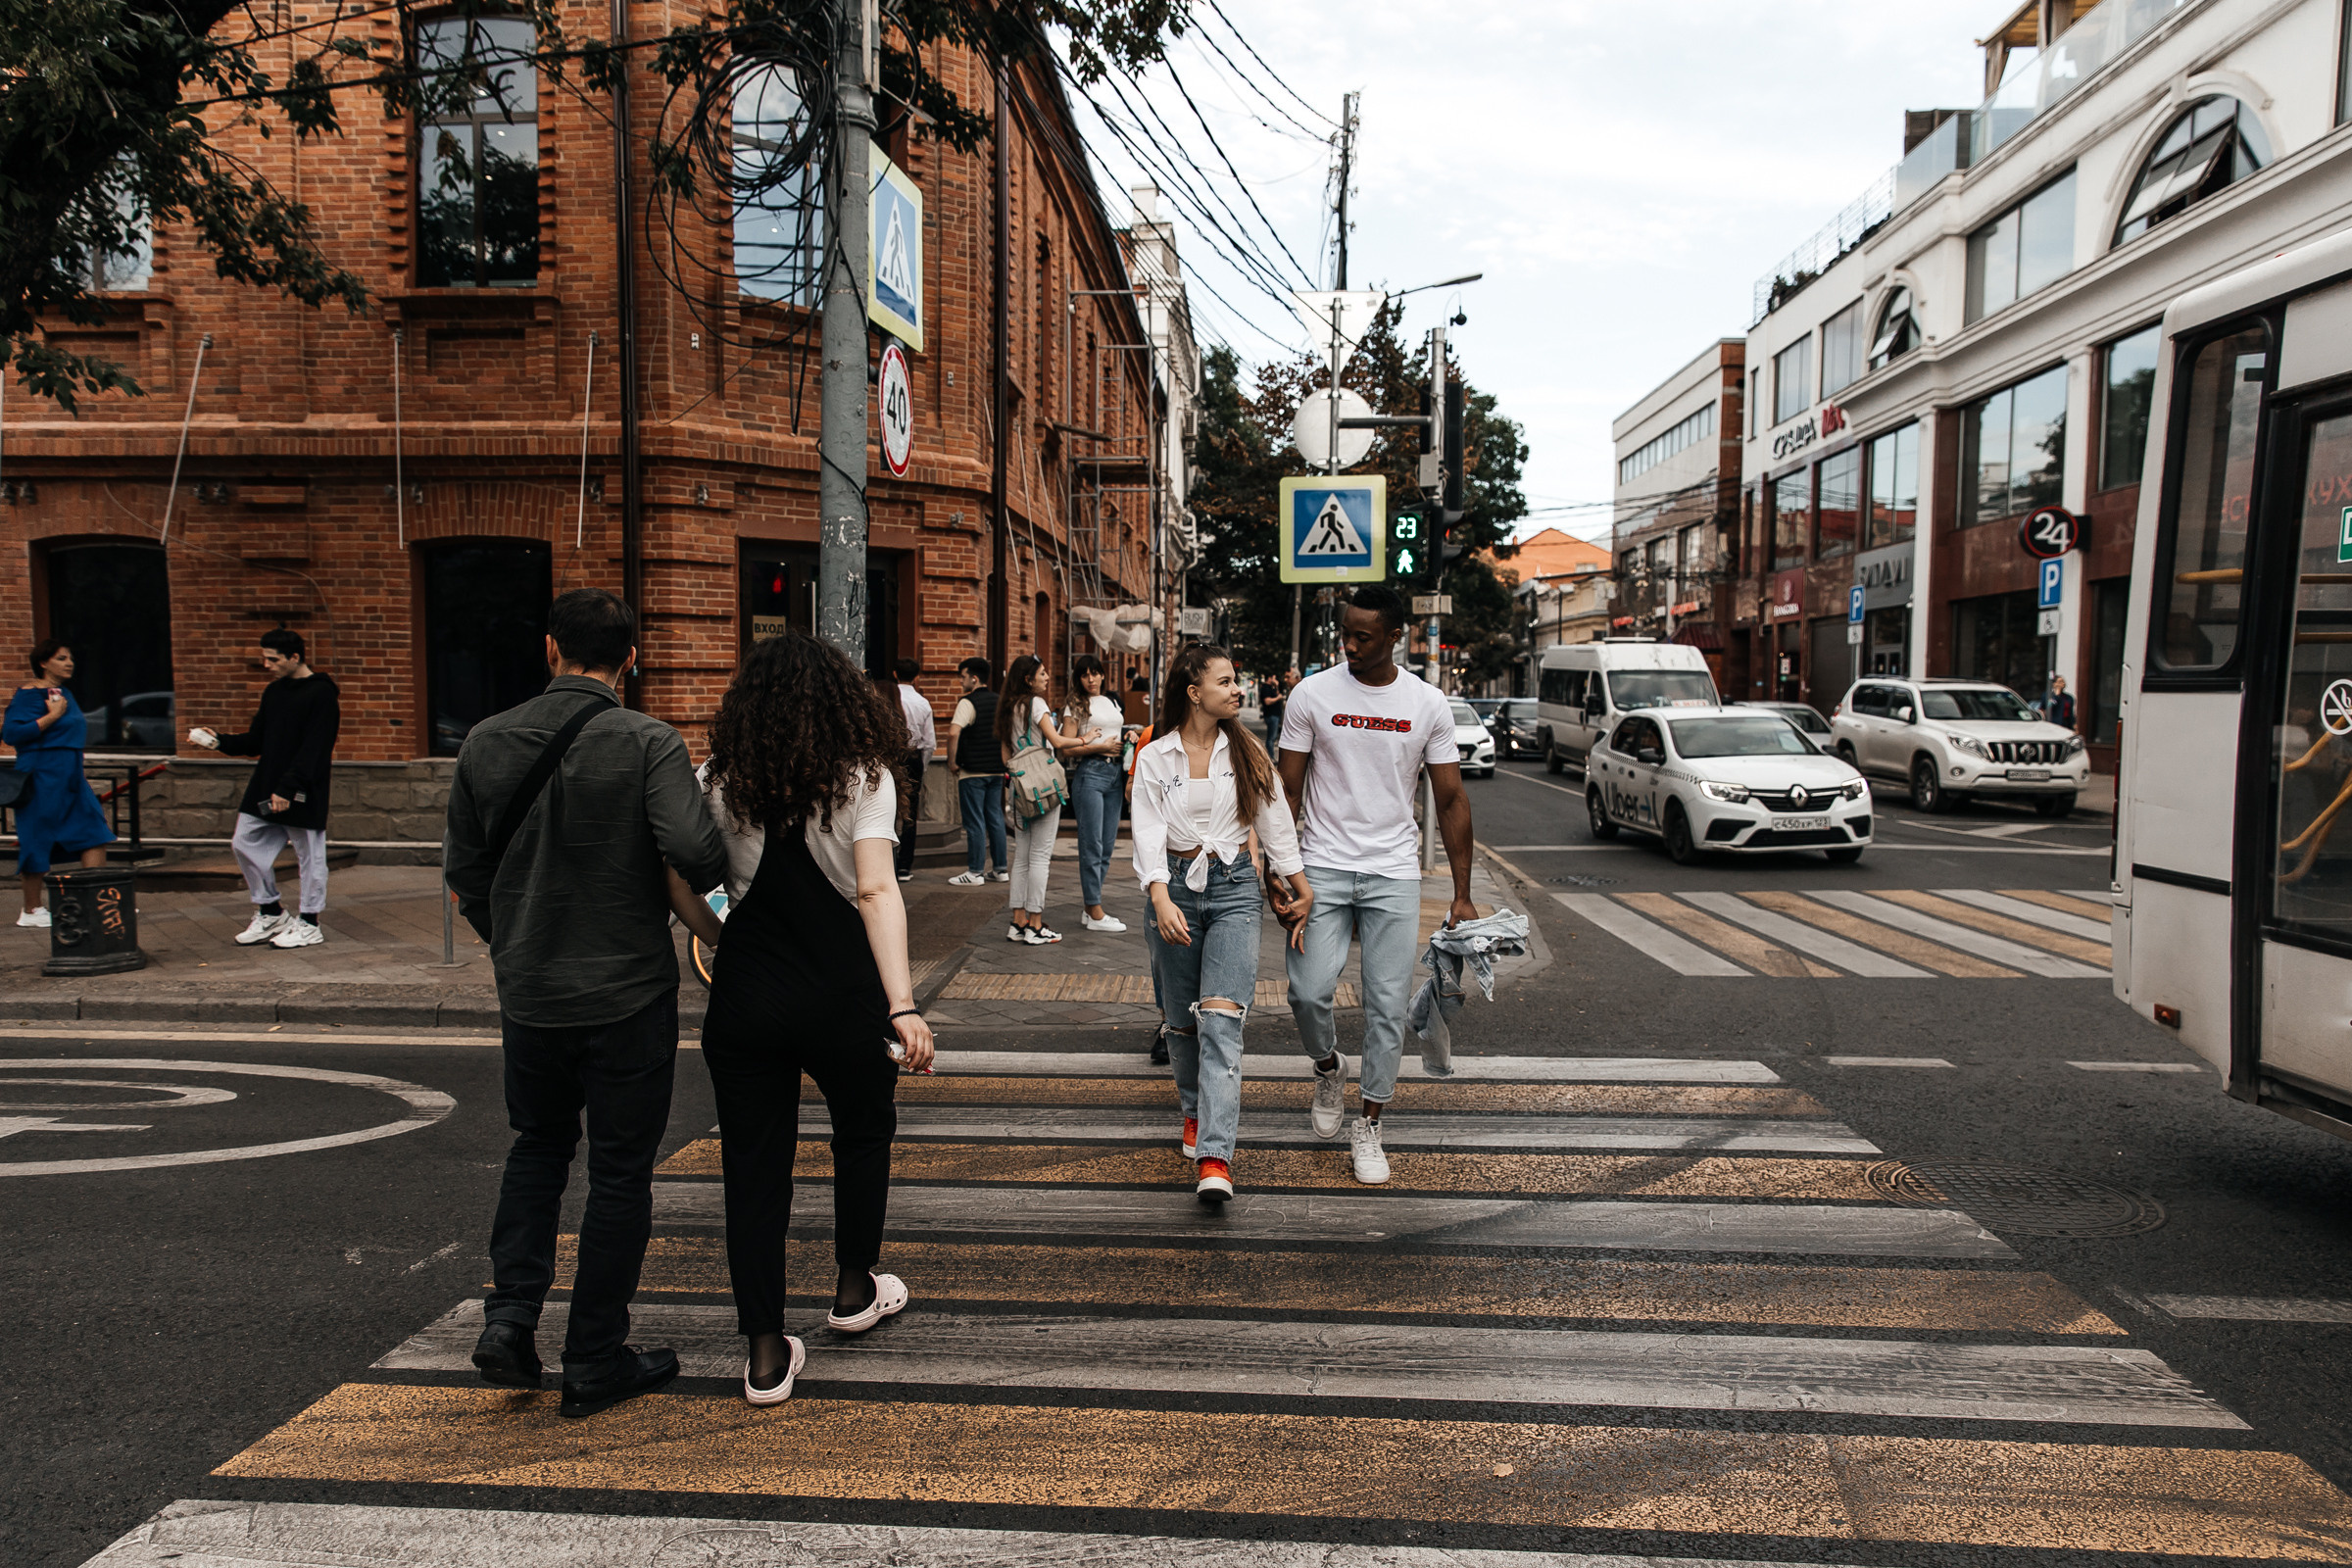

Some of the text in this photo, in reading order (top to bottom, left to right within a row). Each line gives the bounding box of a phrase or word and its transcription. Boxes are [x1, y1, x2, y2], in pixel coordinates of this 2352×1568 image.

[886, 380, 907, 436] 40
[1396, 516, 1417, 539] 23
[2034, 512, 2072, 555] 24
[2044, 563, 2060, 603] P
[1851, 589, 1863, 620] P
[754, 622, 785, 635] ВХОД
[1331, 713, 1412, 733] GUESS
[1604, 780, 1639, 821] Uber
